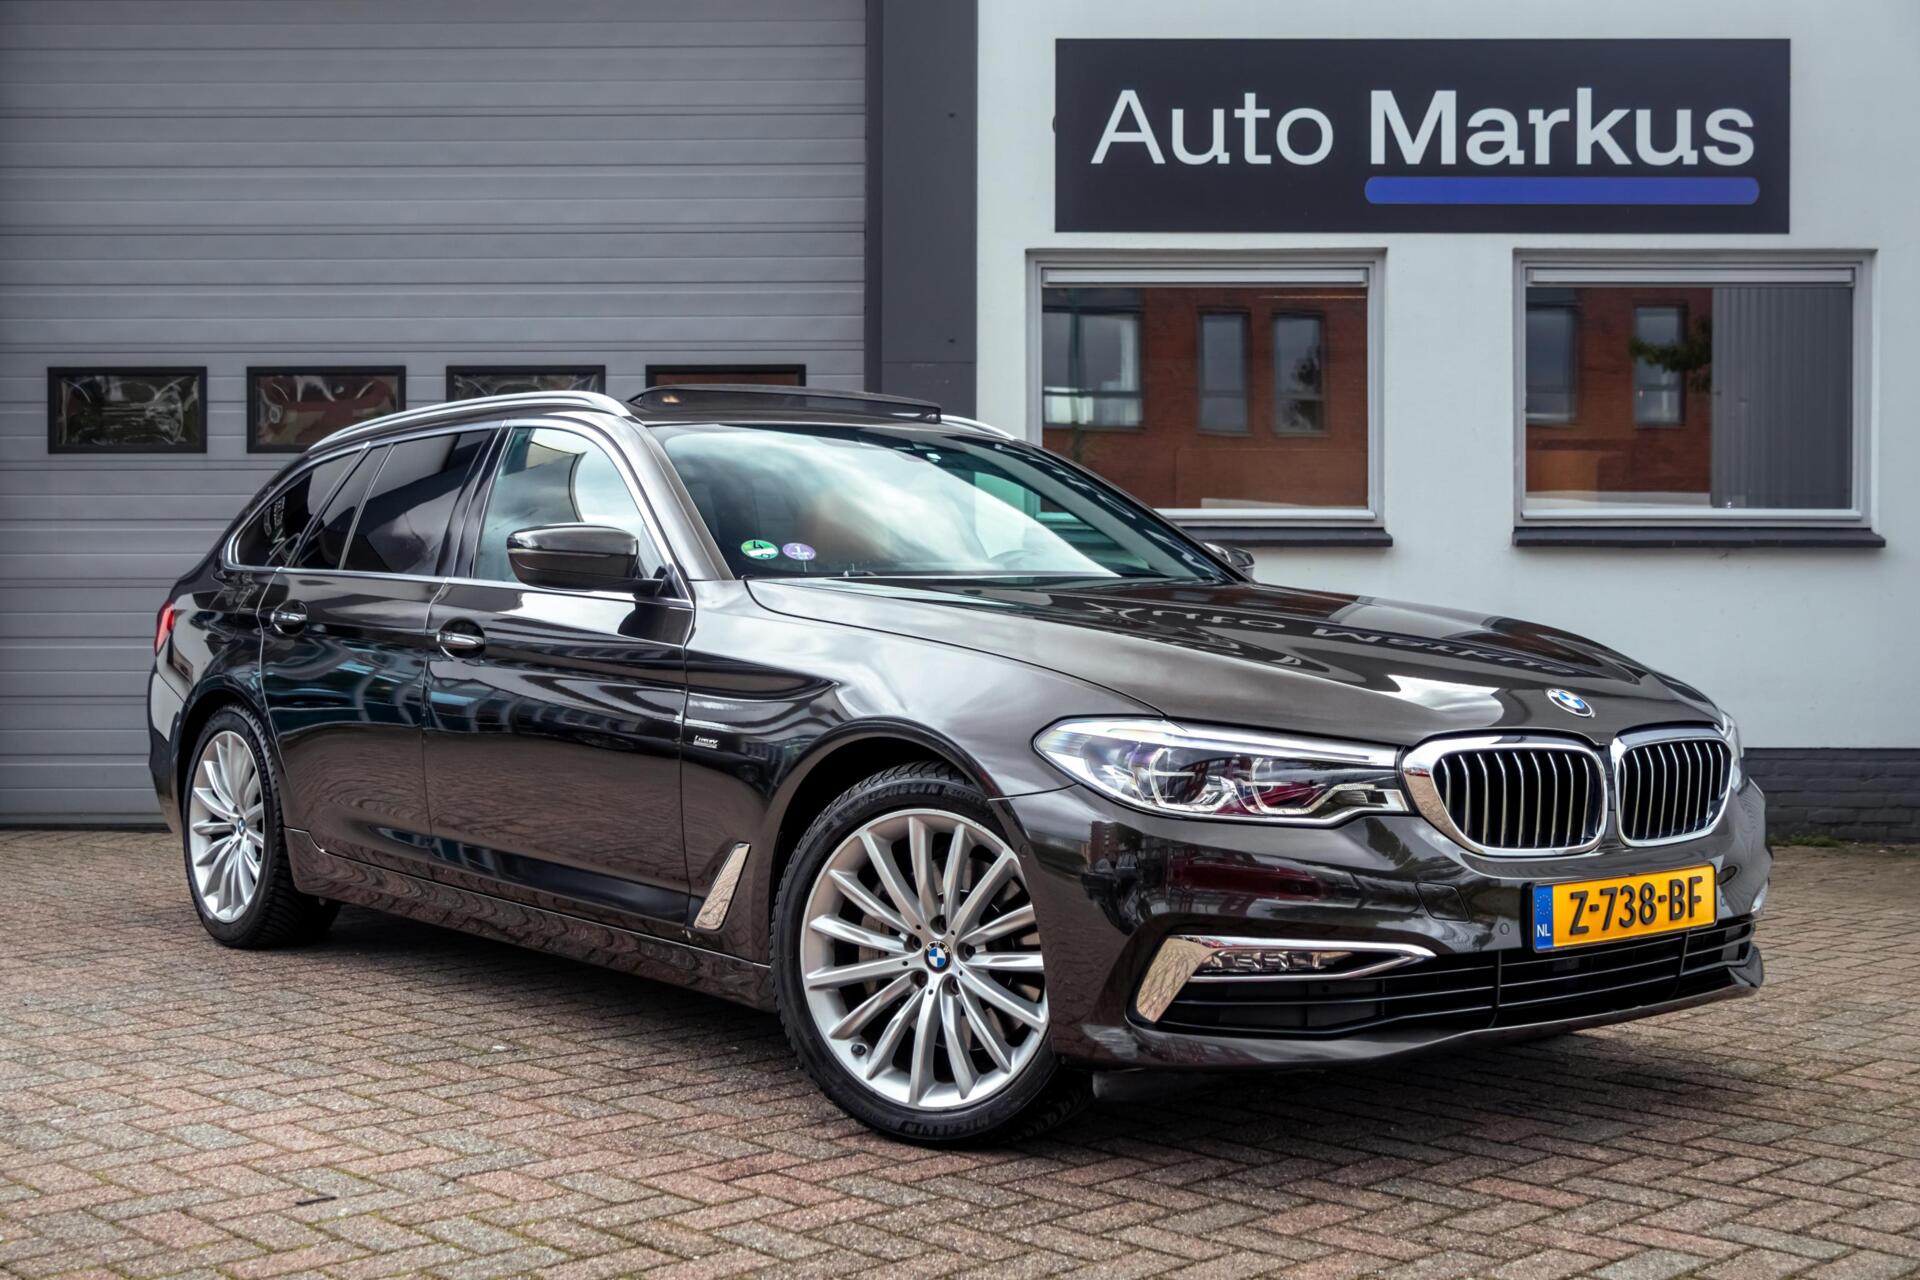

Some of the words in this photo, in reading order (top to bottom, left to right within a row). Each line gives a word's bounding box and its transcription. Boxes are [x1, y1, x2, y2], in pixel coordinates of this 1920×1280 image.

[1091, 89, 1334, 165] Auto
[1369, 87, 1755, 166] Markus
[1536, 923, 1551, 938] NL
[1569, 875, 1703, 936] Z-738-BF
